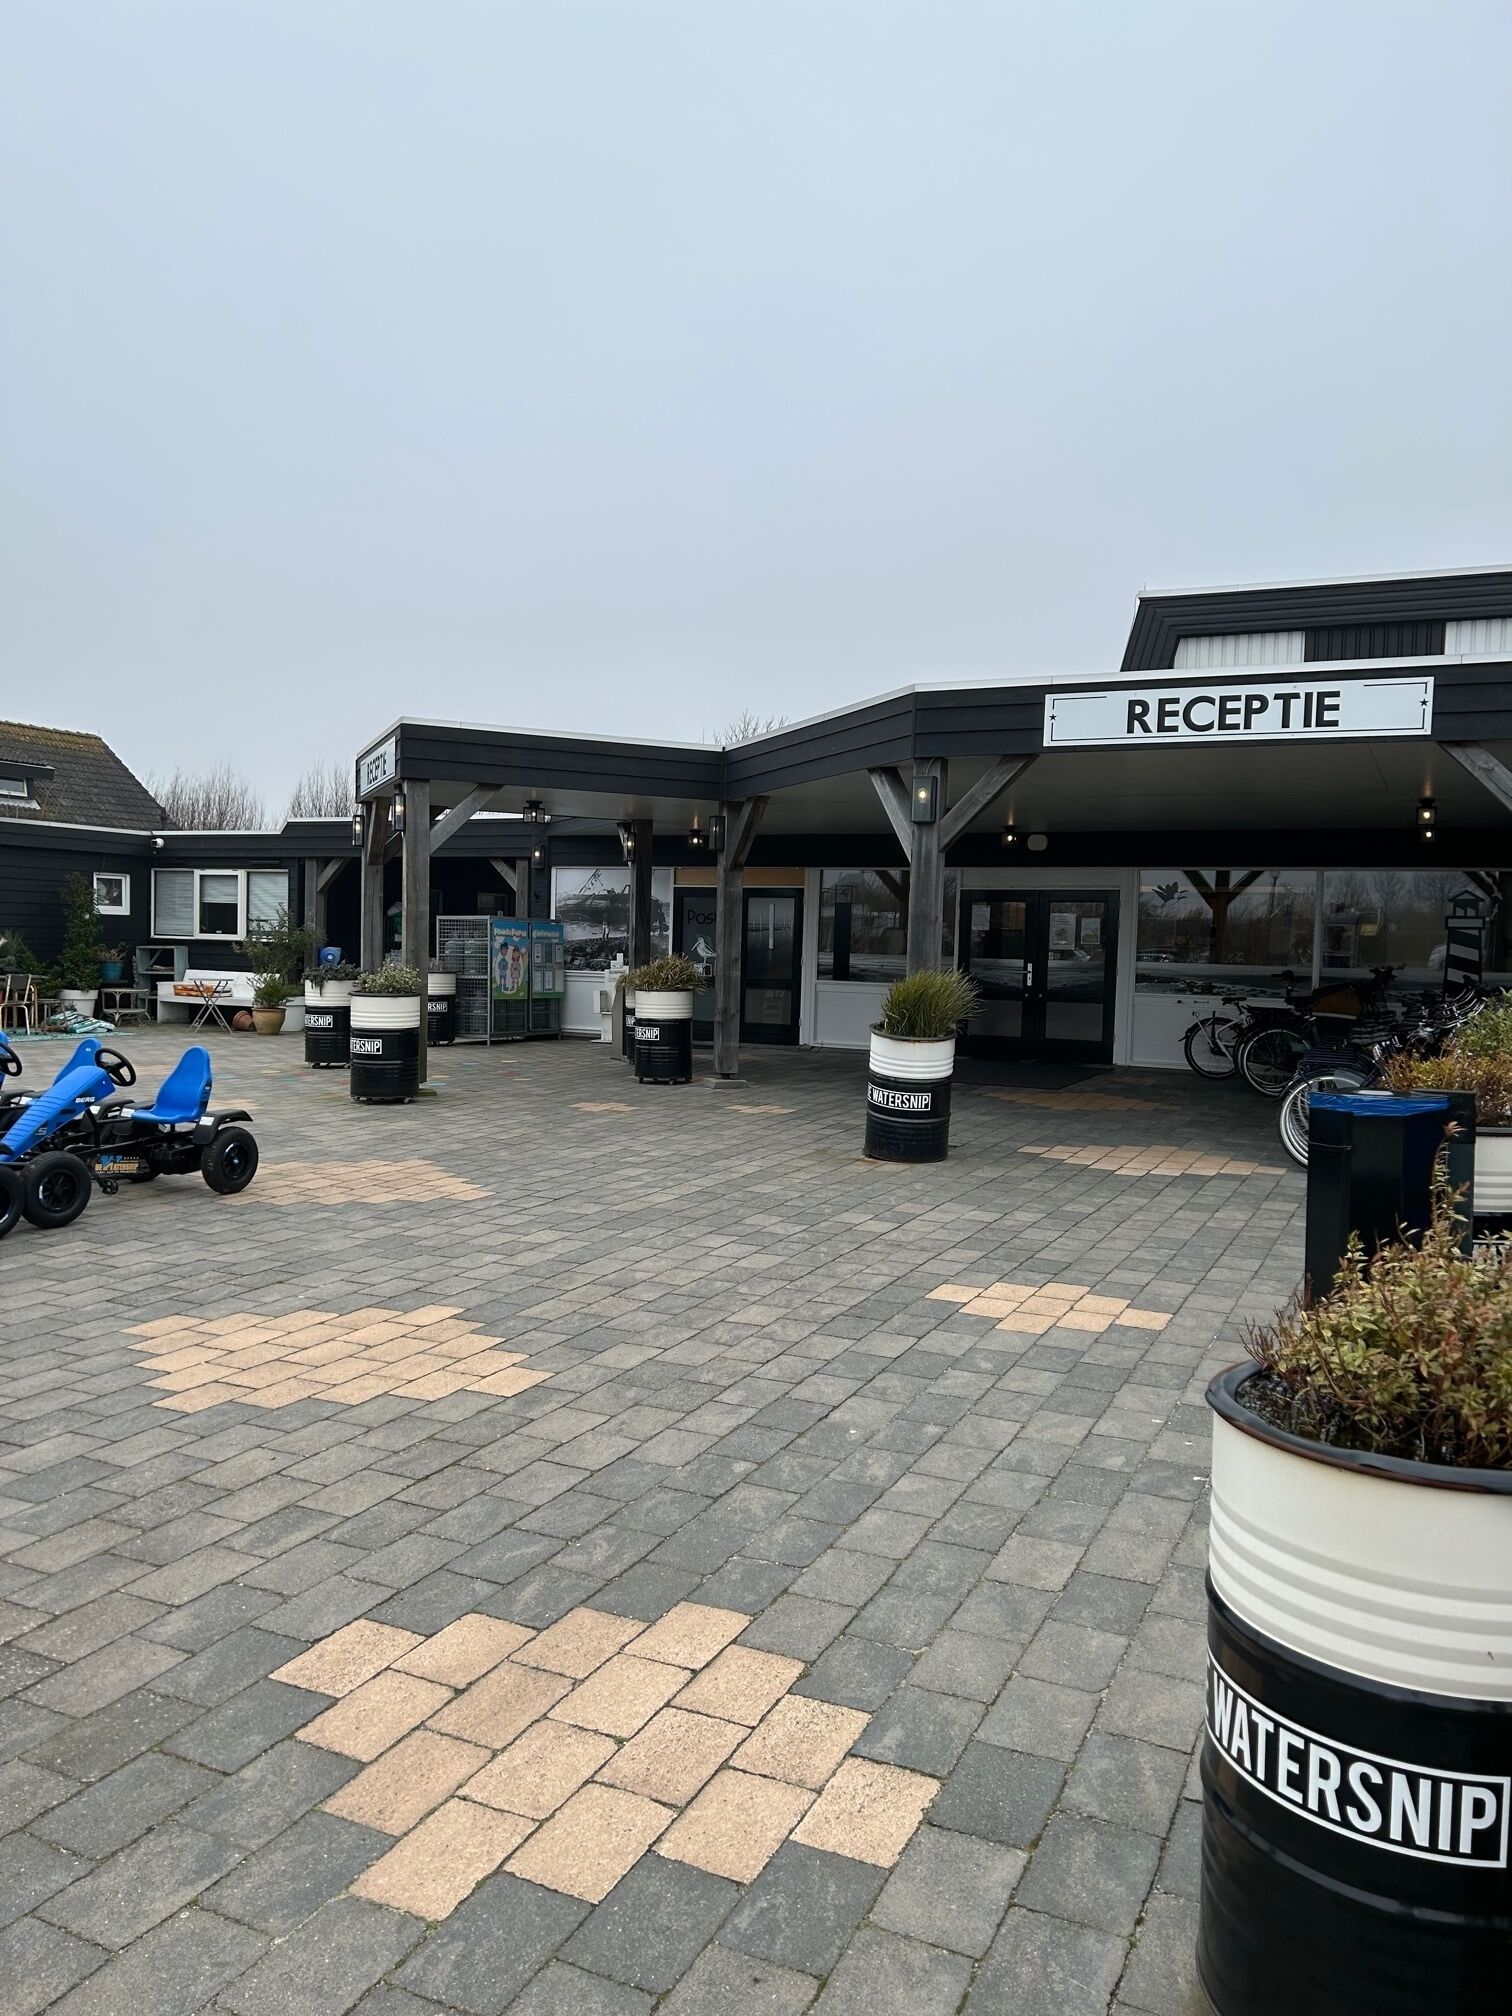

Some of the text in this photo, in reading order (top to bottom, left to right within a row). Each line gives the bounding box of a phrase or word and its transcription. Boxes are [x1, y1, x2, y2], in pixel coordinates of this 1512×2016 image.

[1126, 690, 1341, 734] RECEPTIE
[687, 909, 717, 925] Pos
[75, 1096, 96, 1104] BERG
[872, 1087, 929, 1109] WATERSNIP
[1213, 1669, 1498, 1855] WATERSNIP
